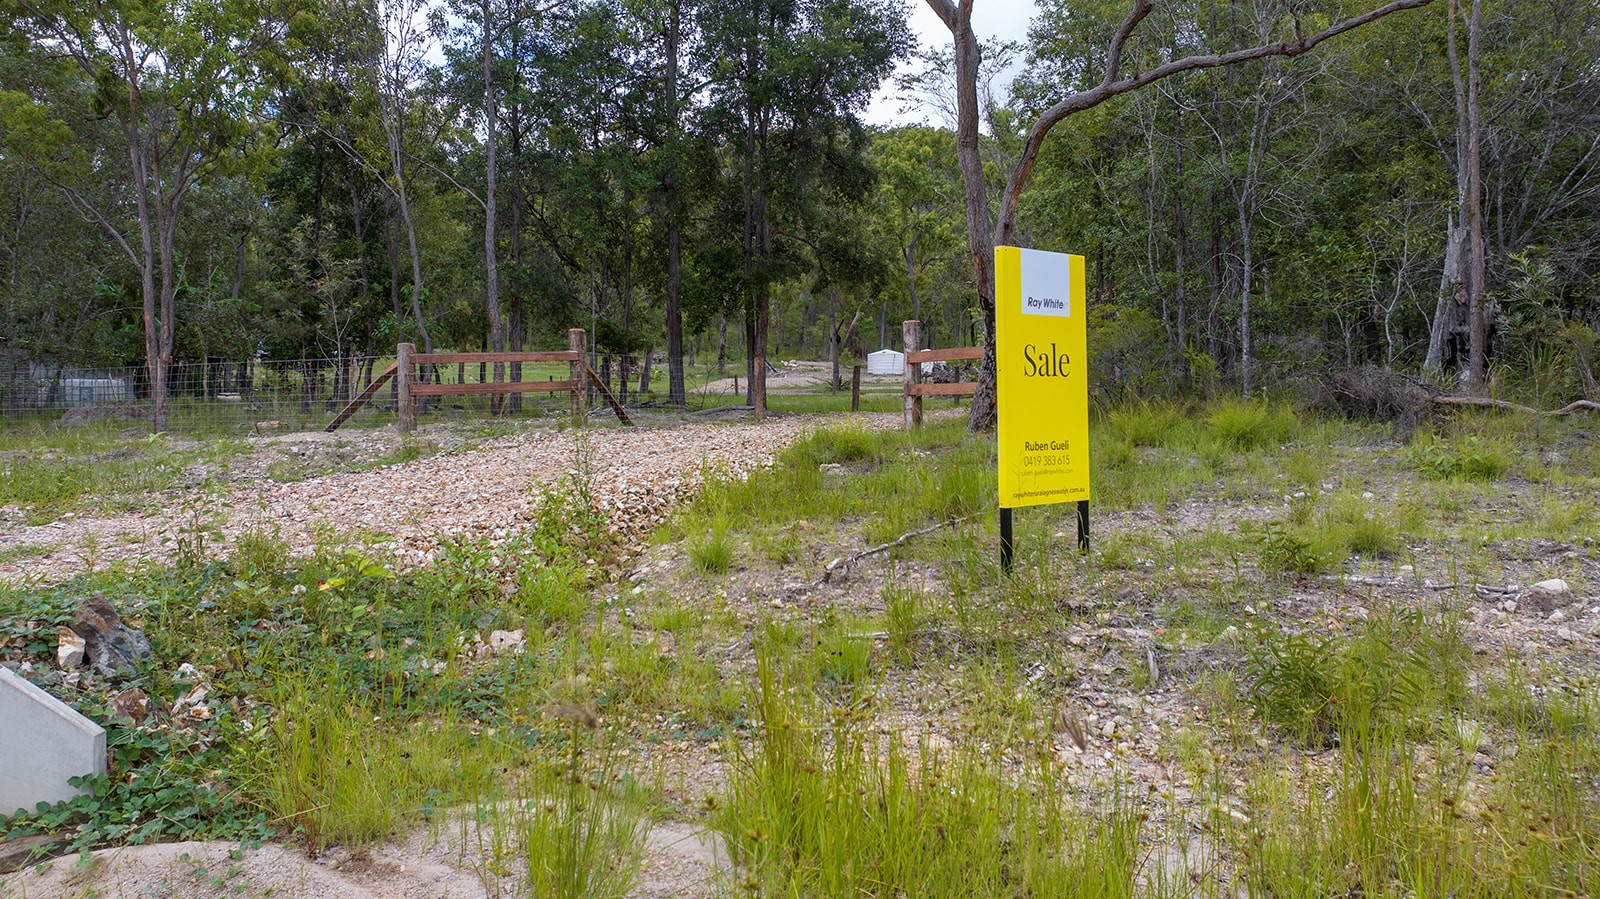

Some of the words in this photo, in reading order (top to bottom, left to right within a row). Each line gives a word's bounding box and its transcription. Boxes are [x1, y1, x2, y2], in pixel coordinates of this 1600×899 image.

[1027, 297, 1043, 309] Ray
[1043, 298, 1064, 309] White
[1024, 343, 1070, 377] Sale
[1025, 441, 1048, 451] Ruben
[1050, 440, 1069, 450] Gueli
[1023, 456, 1041, 467] 0419
[1043, 455, 1056, 466] 383
[1057, 455, 1070, 465] 615
